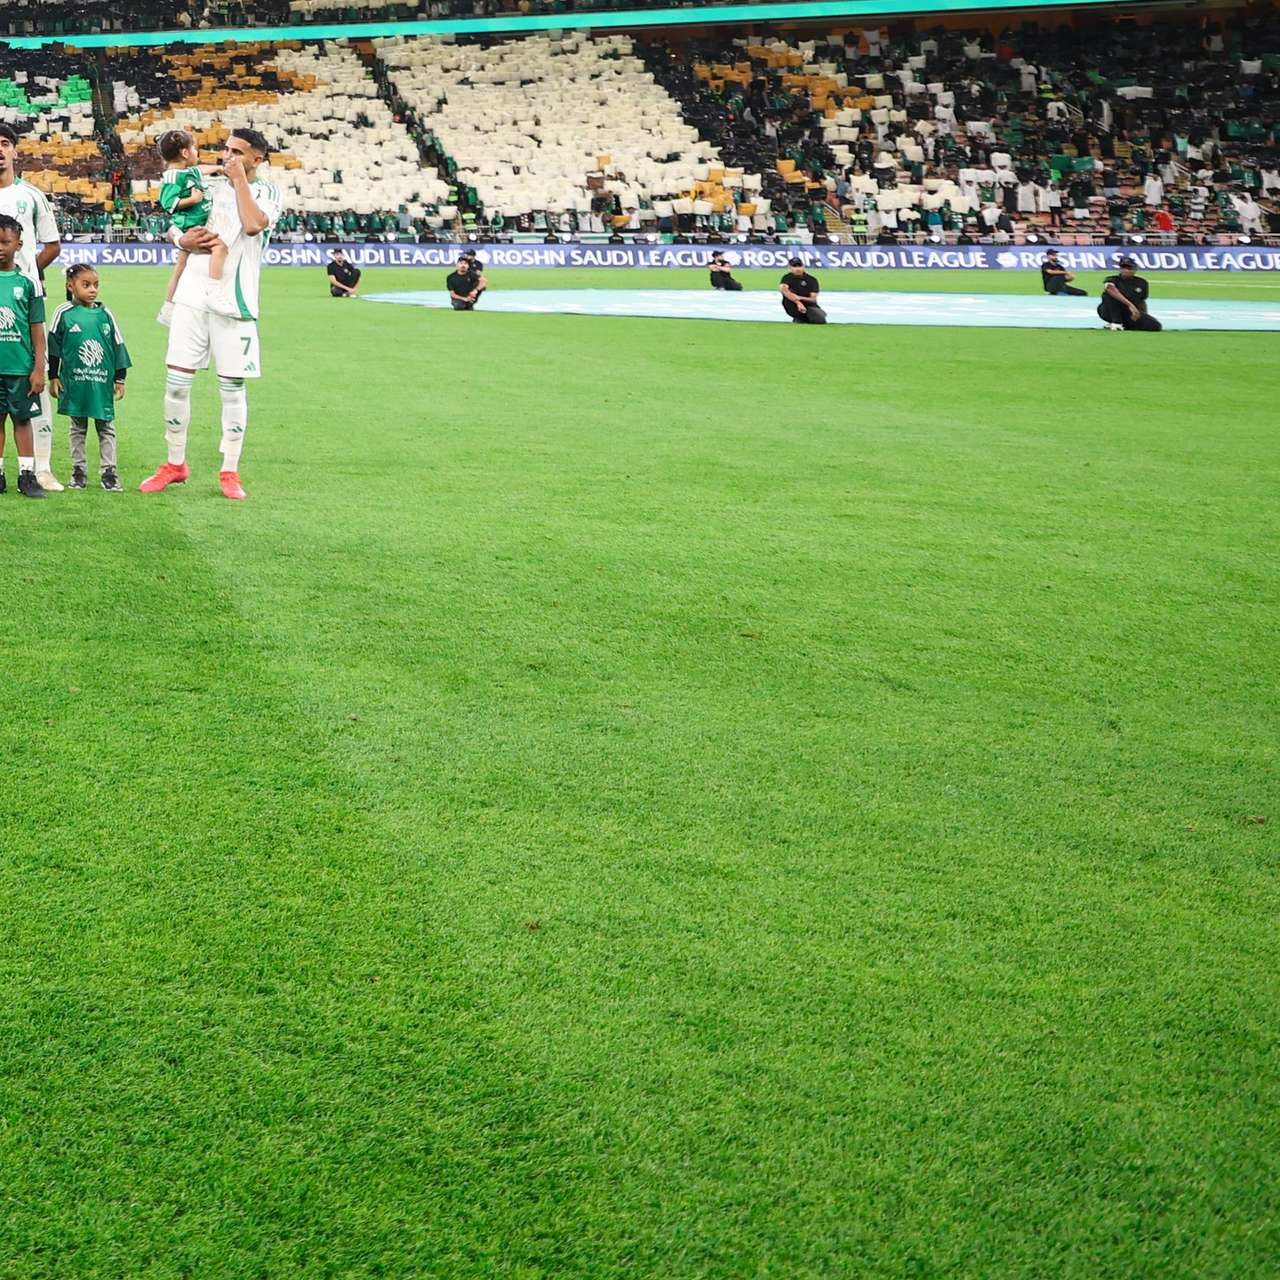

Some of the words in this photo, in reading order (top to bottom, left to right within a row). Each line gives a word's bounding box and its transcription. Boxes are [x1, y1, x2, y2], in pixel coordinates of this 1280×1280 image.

[55, 249, 97, 264] SHN
[102, 249, 158, 264] SAUDI
[493, 250, 565, 266] ROSHN
[571, 250, 634, 266] SAUDI
[826, 251, 895, 268] SAUDI
[901, 251, 989, 268] LEAGUE
[1192, 252, 1280, 270] LEAGUE
[240, 337, 252, 356] 7
